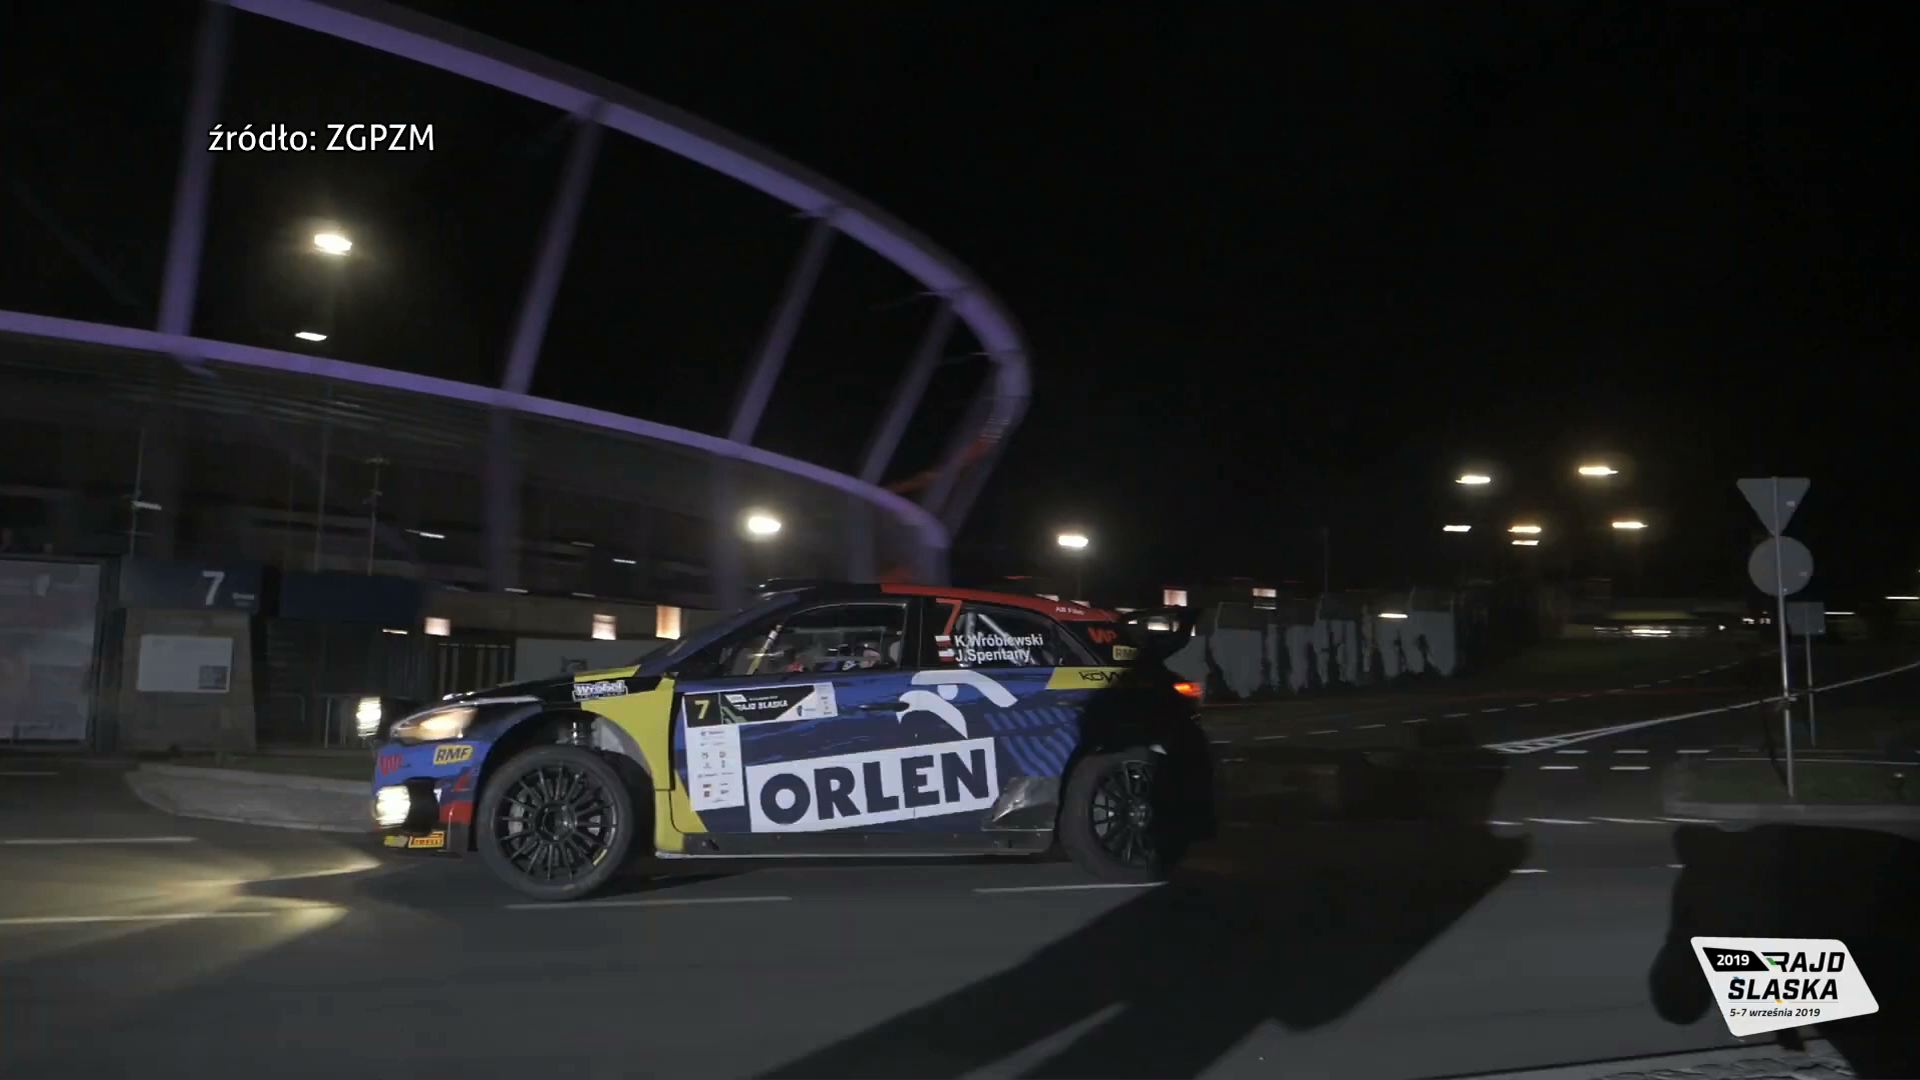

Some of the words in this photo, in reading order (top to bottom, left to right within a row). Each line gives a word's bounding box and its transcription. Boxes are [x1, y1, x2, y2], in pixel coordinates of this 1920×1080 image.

[202, 570, 225, 606] 7
[694, 699, 710, 720] 7
[436, 746, 471, 762] RMF
[760, 749, 989, 825] ORLEN
